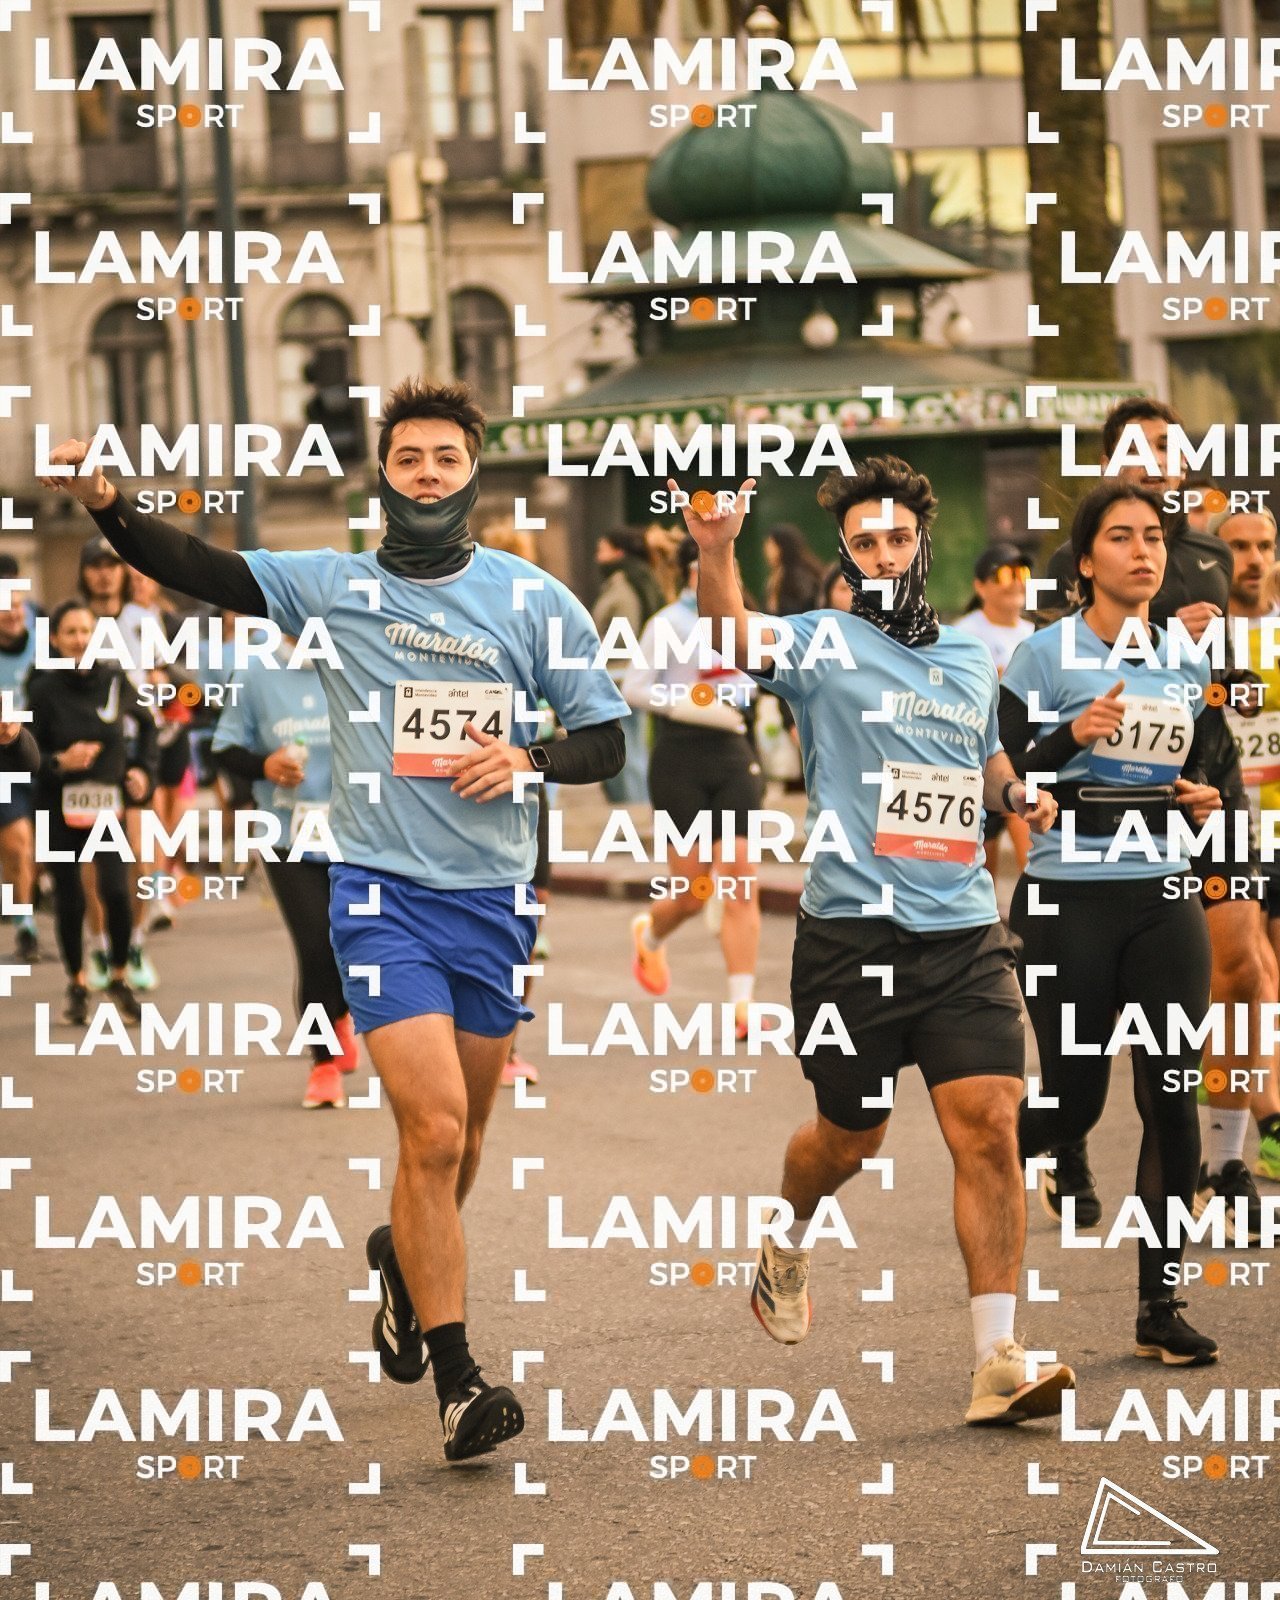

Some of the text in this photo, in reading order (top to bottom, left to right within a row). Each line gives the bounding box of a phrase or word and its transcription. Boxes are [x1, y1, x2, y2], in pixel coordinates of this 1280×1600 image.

[385, 623, 499, 666] Maratón
[402, 708, 503, 741] 4574
[893, 691, 986, 736] Maratón
[895, 725, 976, 747] MONTEVIDEO
[886, 789, 976, 828] 4576
